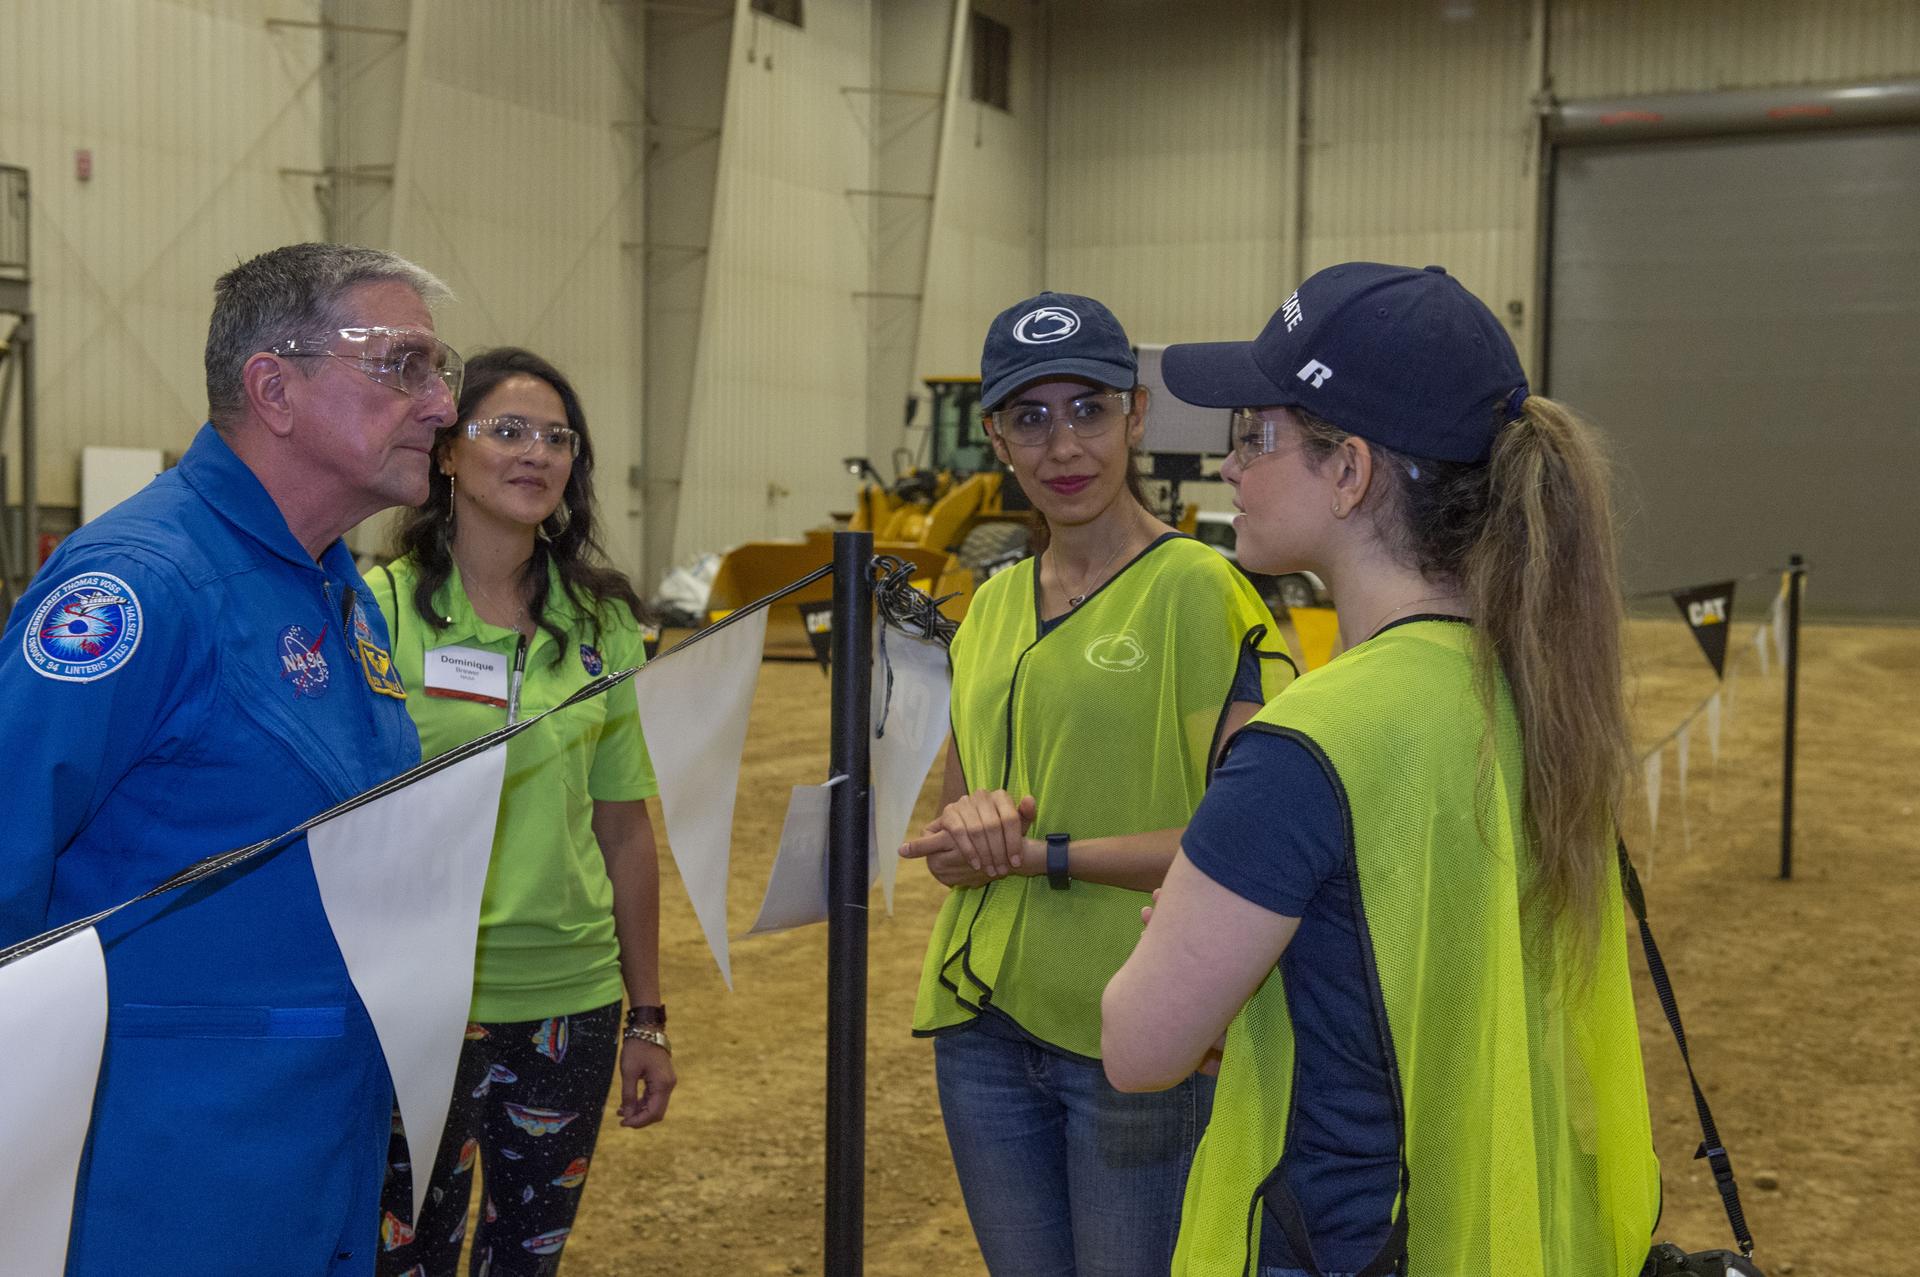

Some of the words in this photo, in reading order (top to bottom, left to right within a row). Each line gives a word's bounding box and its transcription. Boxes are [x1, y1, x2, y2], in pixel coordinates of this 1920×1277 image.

[1281, 288, 1303, 333] TATE
[62, 577, 98, 593] THOMAS
[99, 579, 121, 594] VOSS
[124, 605, 137, 641] HALSELL
[807, 611, 833, 634] CAT
[1688, 597, 1727, 627] CAT
[28, 637, 46, 665] CROUCH
[46, 661, 59, 672] 94
[64, 660, 108, 674] LINTERIS
[107, 643, 129, 663] STILL
[281, 651, 328, 673] NASA
[441, 655, 494, 671] Dominique
